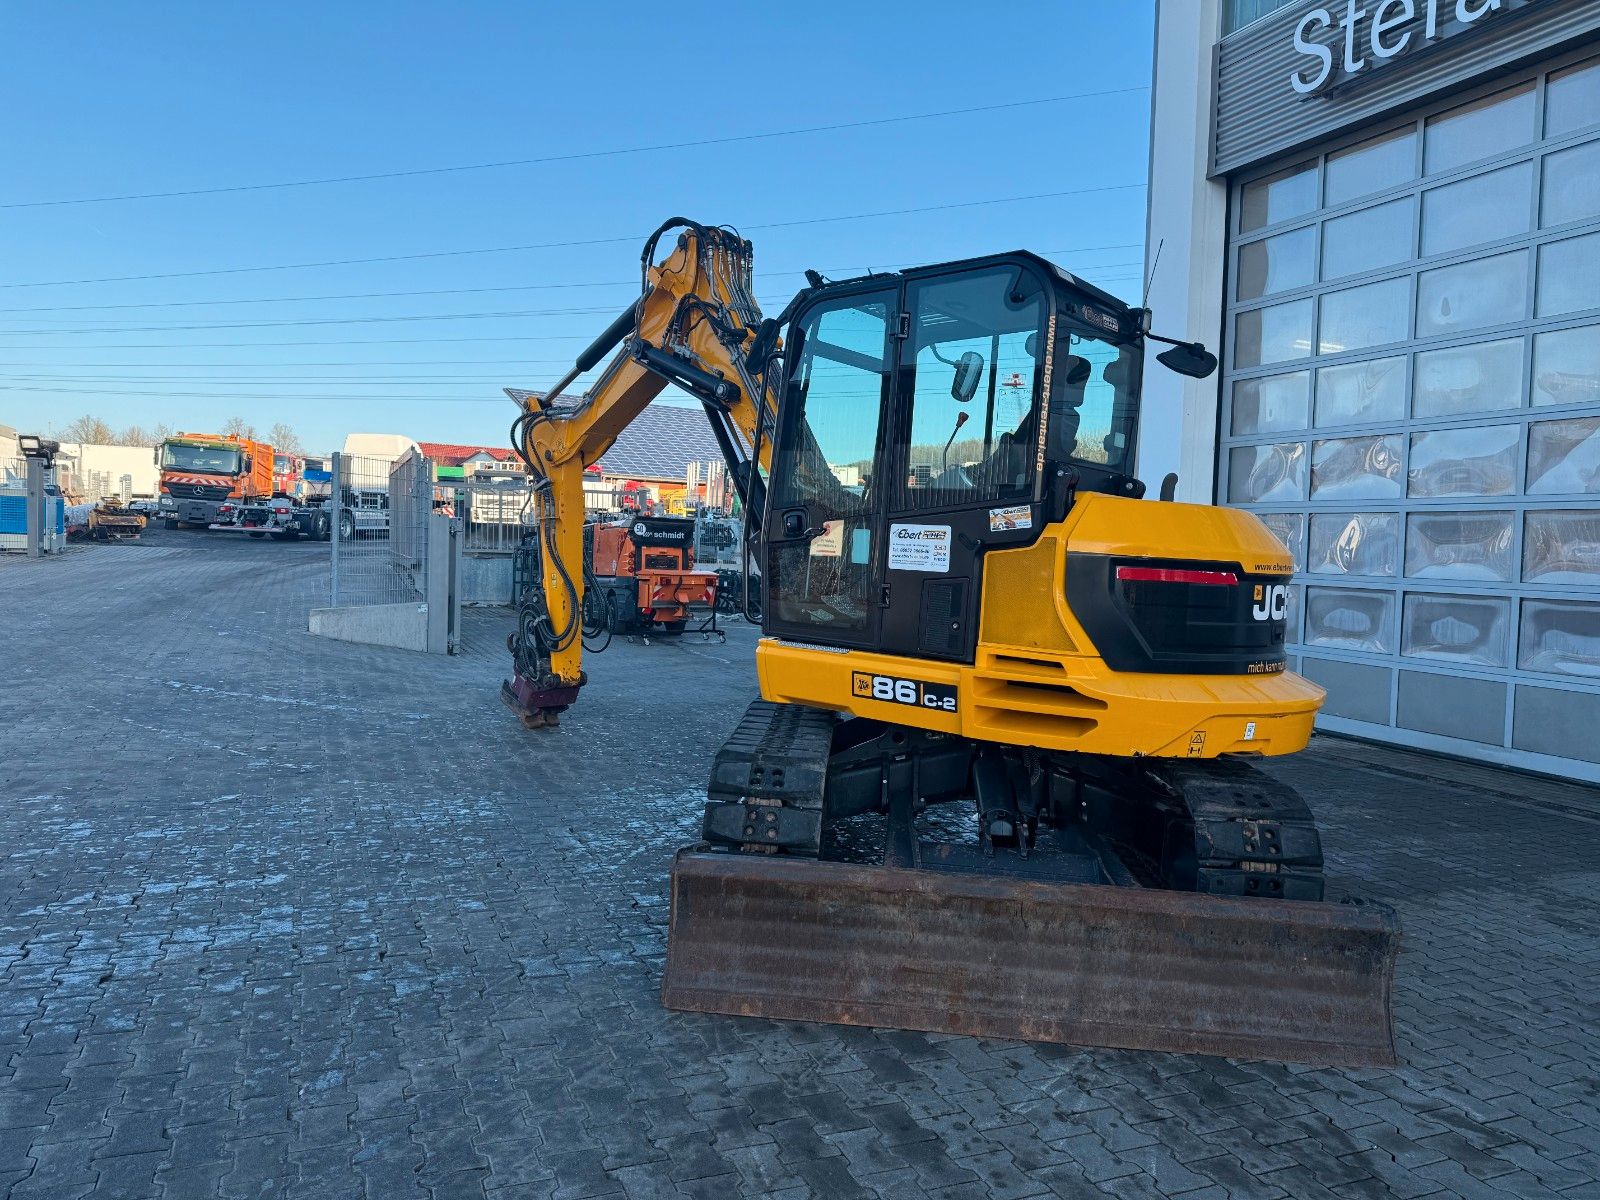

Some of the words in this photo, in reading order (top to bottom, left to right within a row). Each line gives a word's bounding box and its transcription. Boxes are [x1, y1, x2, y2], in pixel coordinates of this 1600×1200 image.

[1036, 315, 1056, 472] www.ebert-rental.de
[636, 524, 644, 533] 50
[898, 528, 922, 540] Ebert
[653, 531, 685, 540] schmidt
[1247, 661, 1264, 673] mich
[872, 676, 917, 704] 86
[924, 694, 956, 711] C-2
